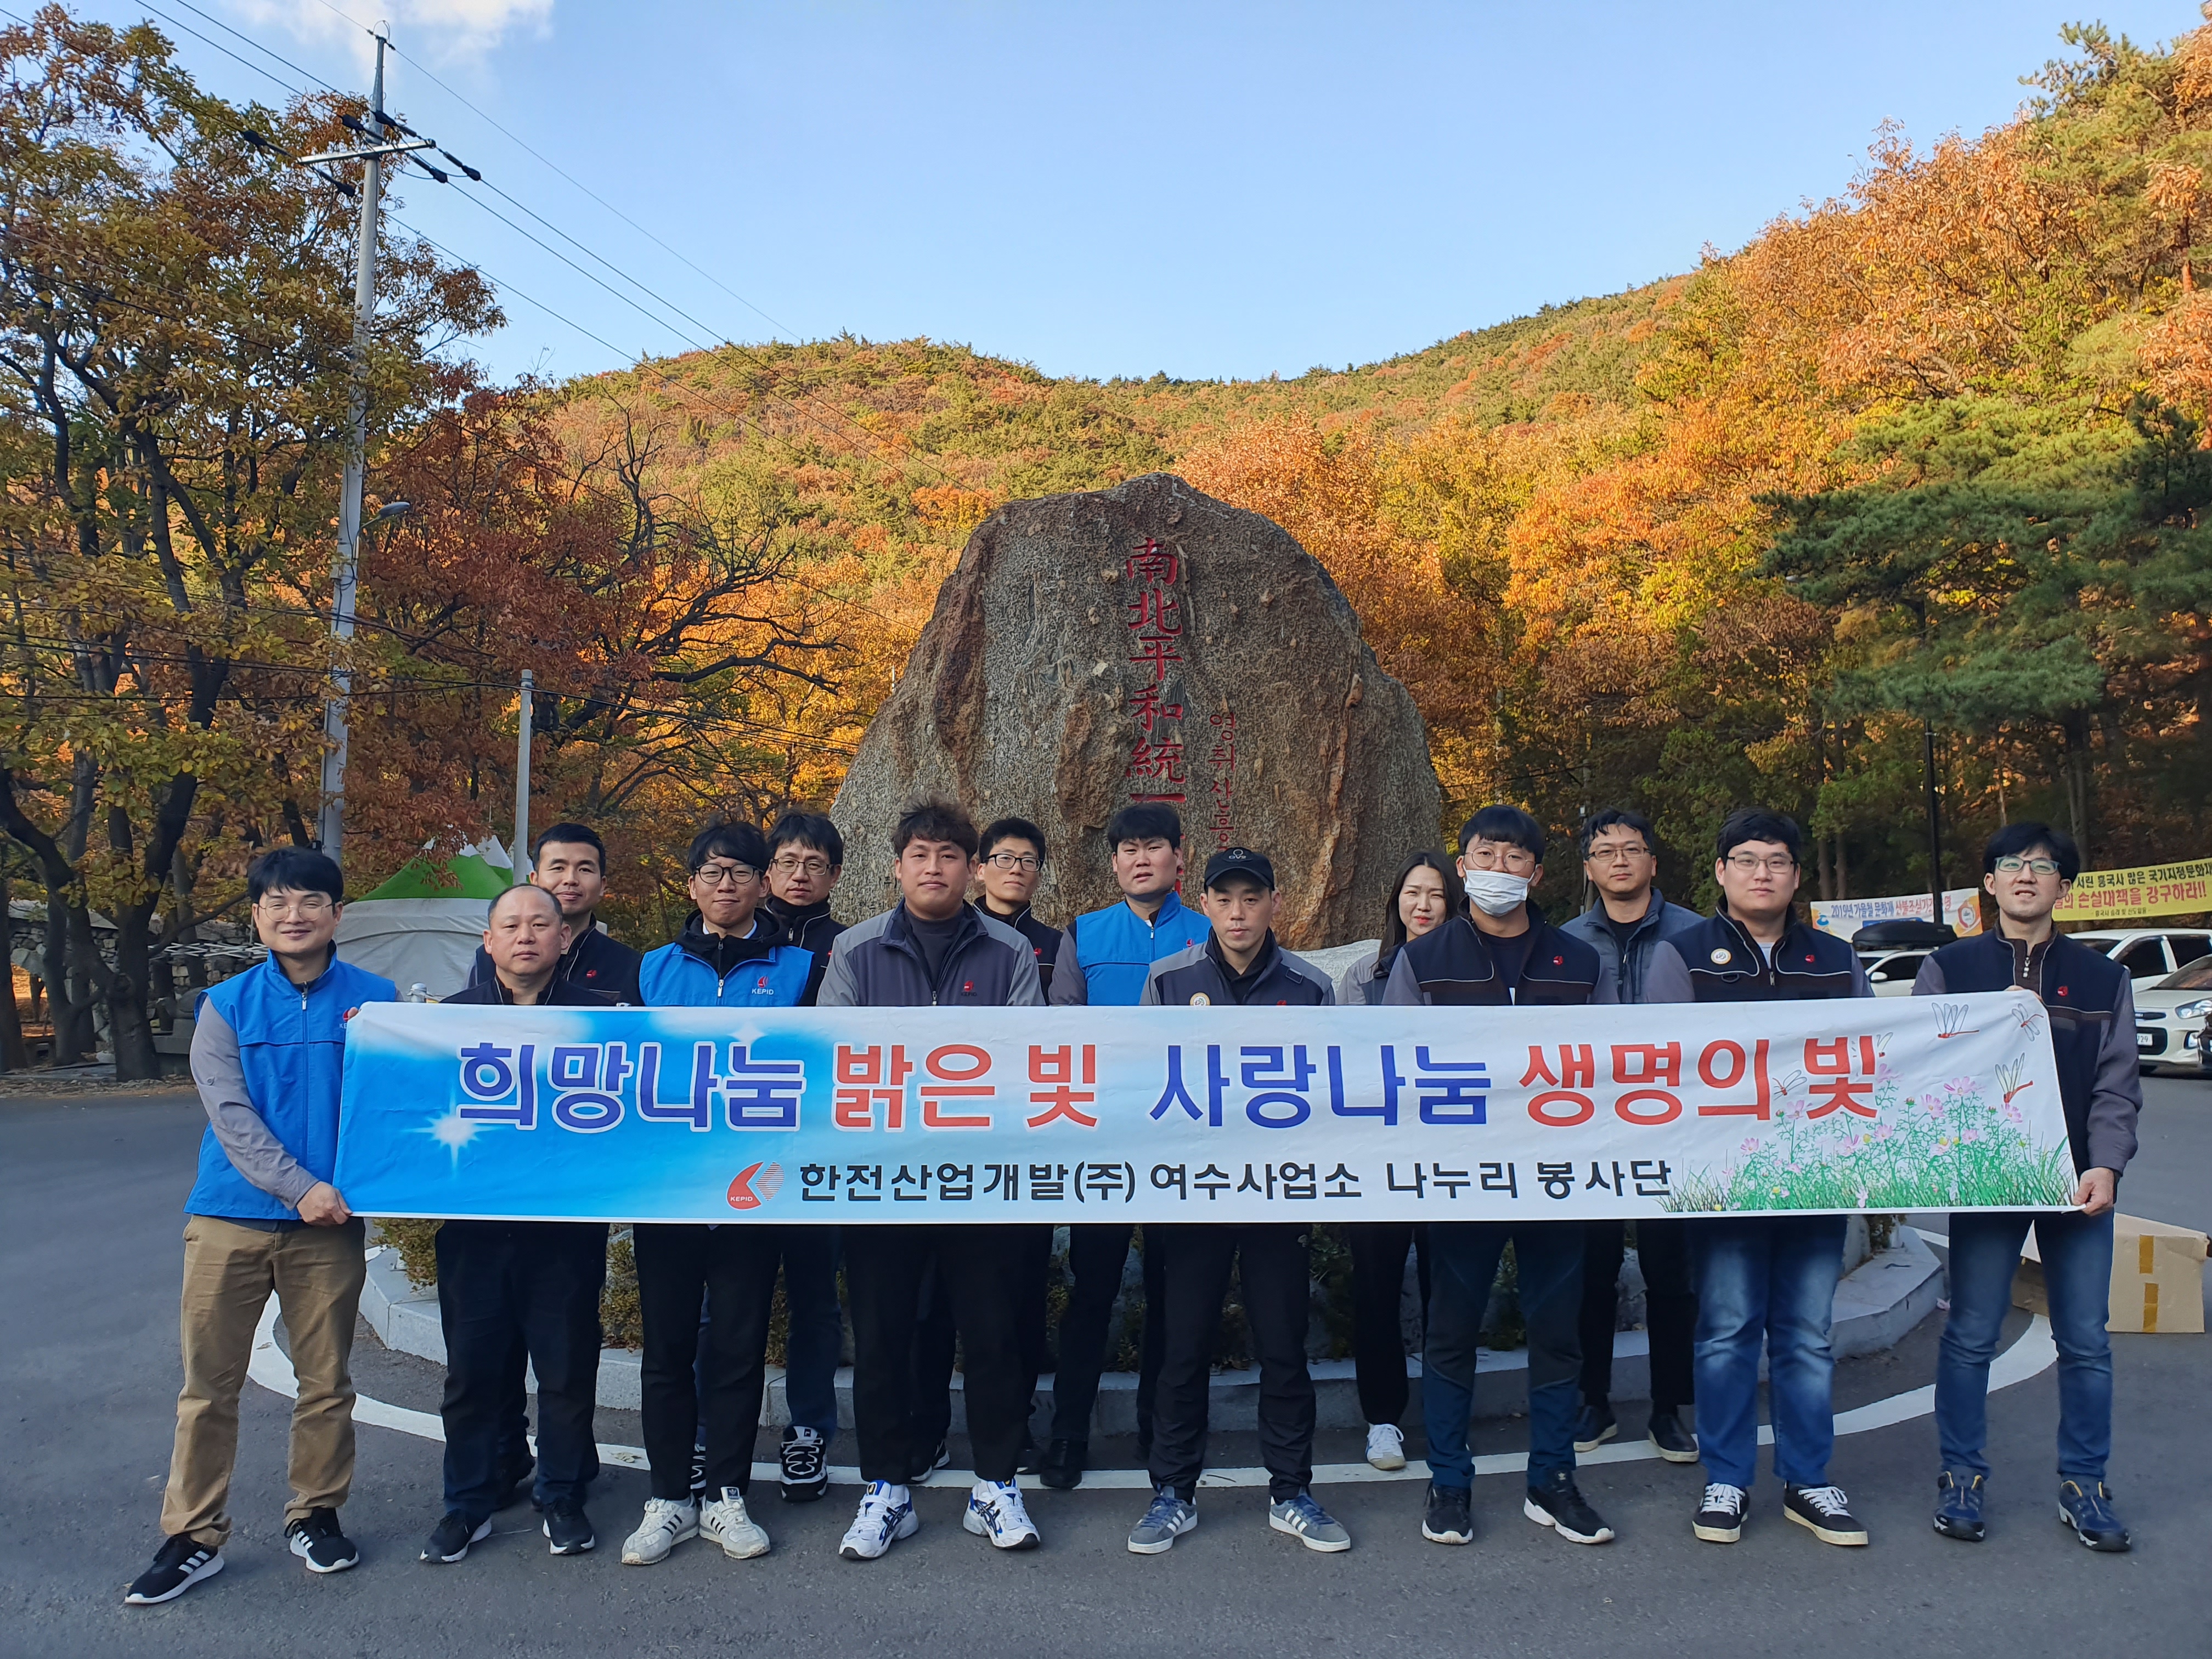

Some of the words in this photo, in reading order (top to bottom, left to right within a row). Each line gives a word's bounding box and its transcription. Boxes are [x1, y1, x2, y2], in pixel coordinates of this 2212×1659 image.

[1126, 537, 1187, 803] 南北平和統一
[1209, 712, 1235, 850] 영취산흥
[2078, 887, 2142, 909] 손실대책을
[2146, 881, 2207, 904] 강구하라!!
[2097, 873, 2124, 888] 흥국사
[2128, 871, 2146, 885] 많은
[1831, 903, 1854, 918] 2019년
[1854, 902, 1874, 918] 가을철
[1874, 900, 1894, 917] 문화재
[460, 1042, 803, 1129] 희망나눔
[835, 1043, 996, 1128] 밝은
[1026, 1043, 1098, 1128] 빛
[1149, 1043, 1492, 1128] 사랑나눔
[1518, 1039, 1771, 1127] 생명의
[1803, 1035, 1878, 1120] 빛
[799, 1160, 1136, 1204] 한전산업개발(주)
[1150, 1161, 1362, 1200] 여수사업소
[1386, 1162, 1519, 1199] 나누리
[1537, 1160, 1672, 1199] 봉사단
